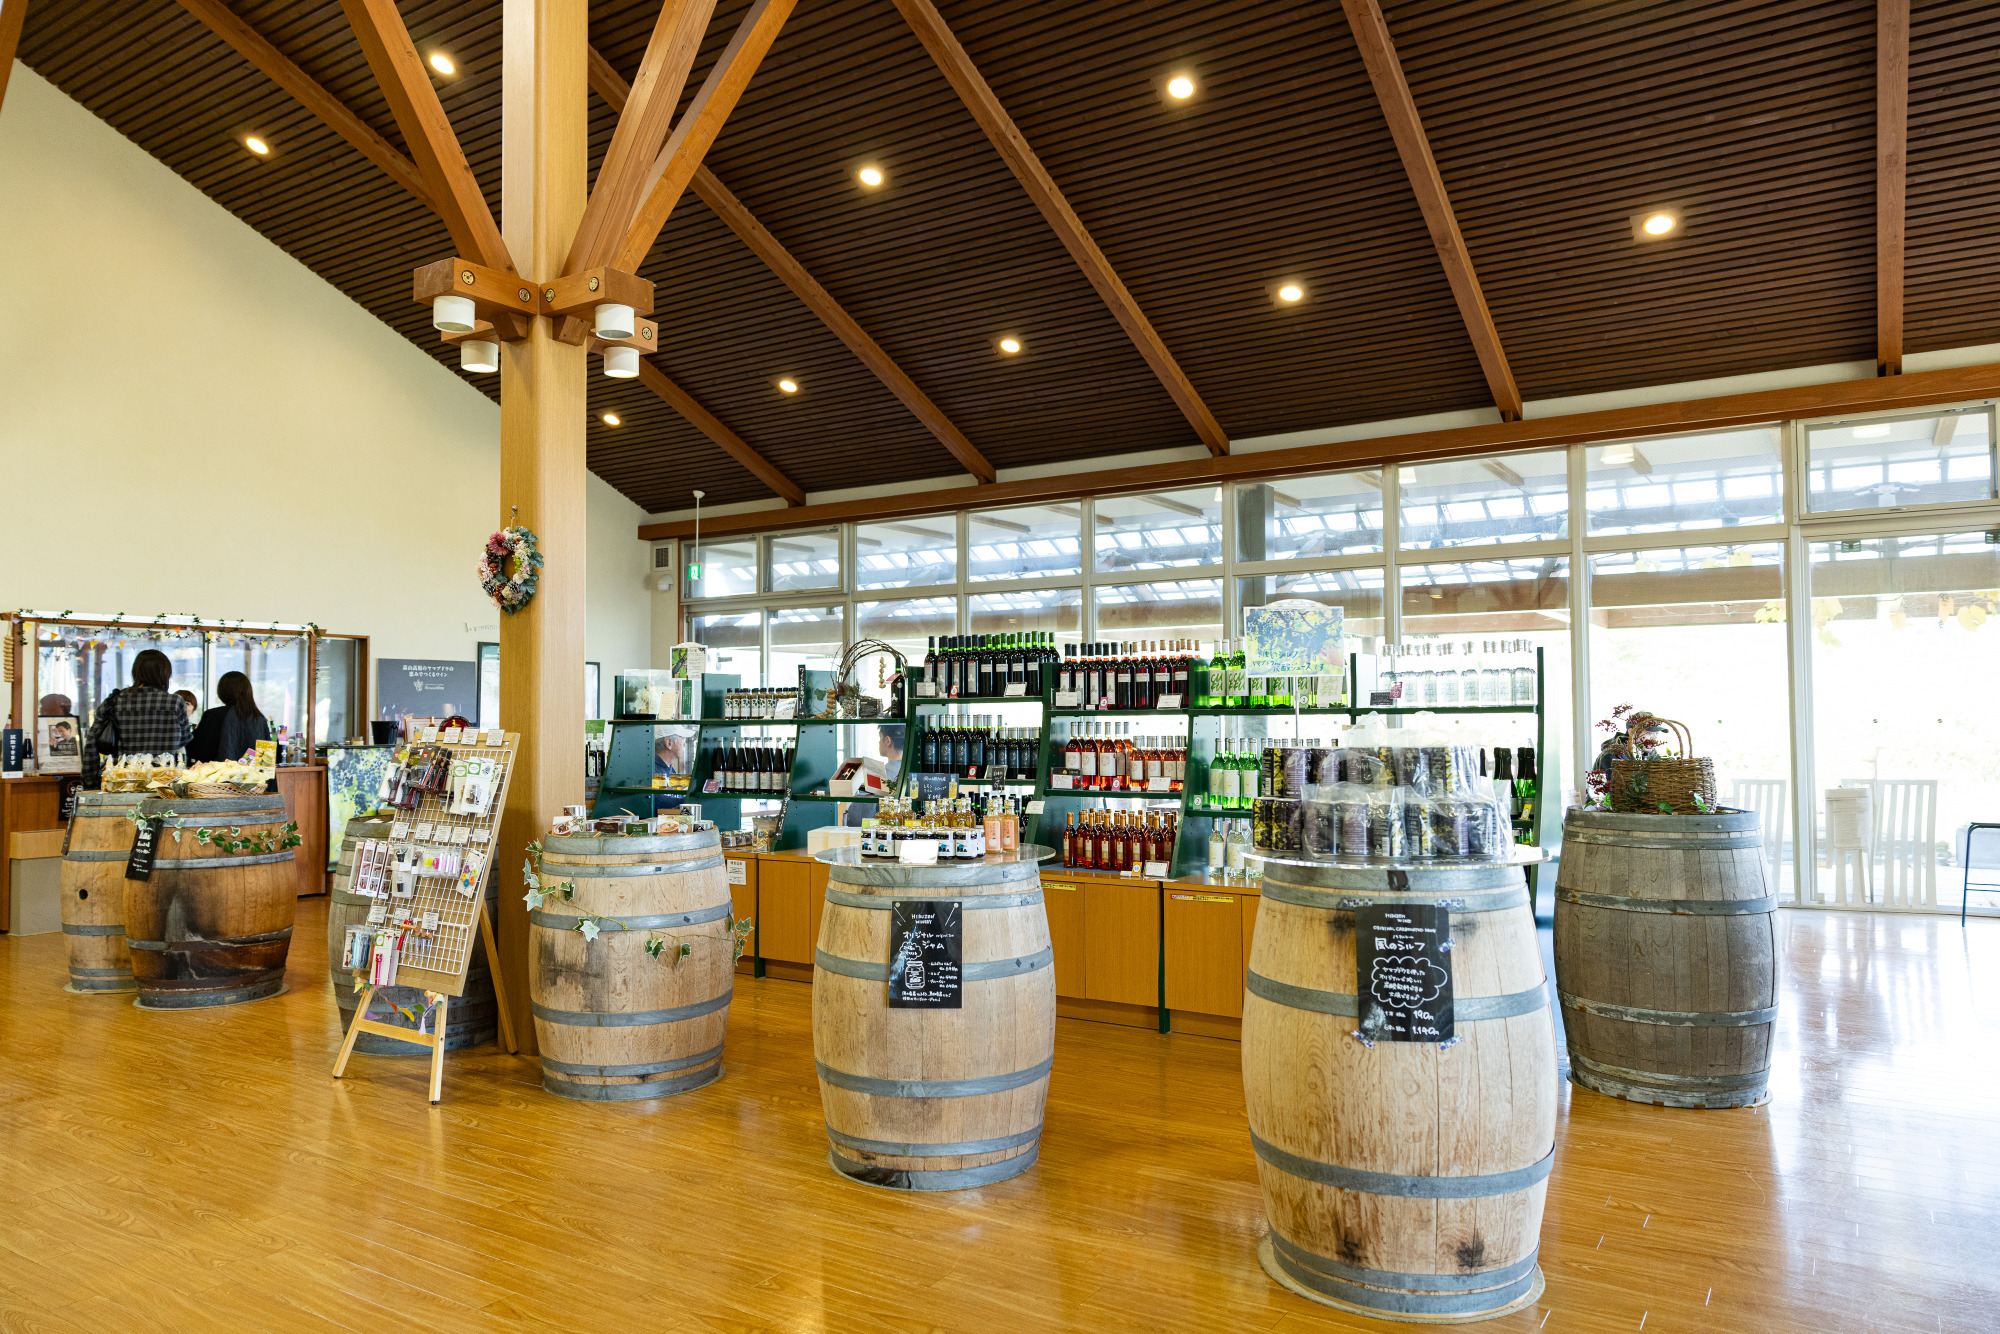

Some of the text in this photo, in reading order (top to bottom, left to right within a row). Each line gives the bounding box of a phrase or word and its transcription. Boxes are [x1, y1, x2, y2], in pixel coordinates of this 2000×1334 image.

[903, 931, 934, 939] オリジナル
[922, 940, 944, 949] ジャム
[1375, 937, 1425, 951] 風のシルフ
